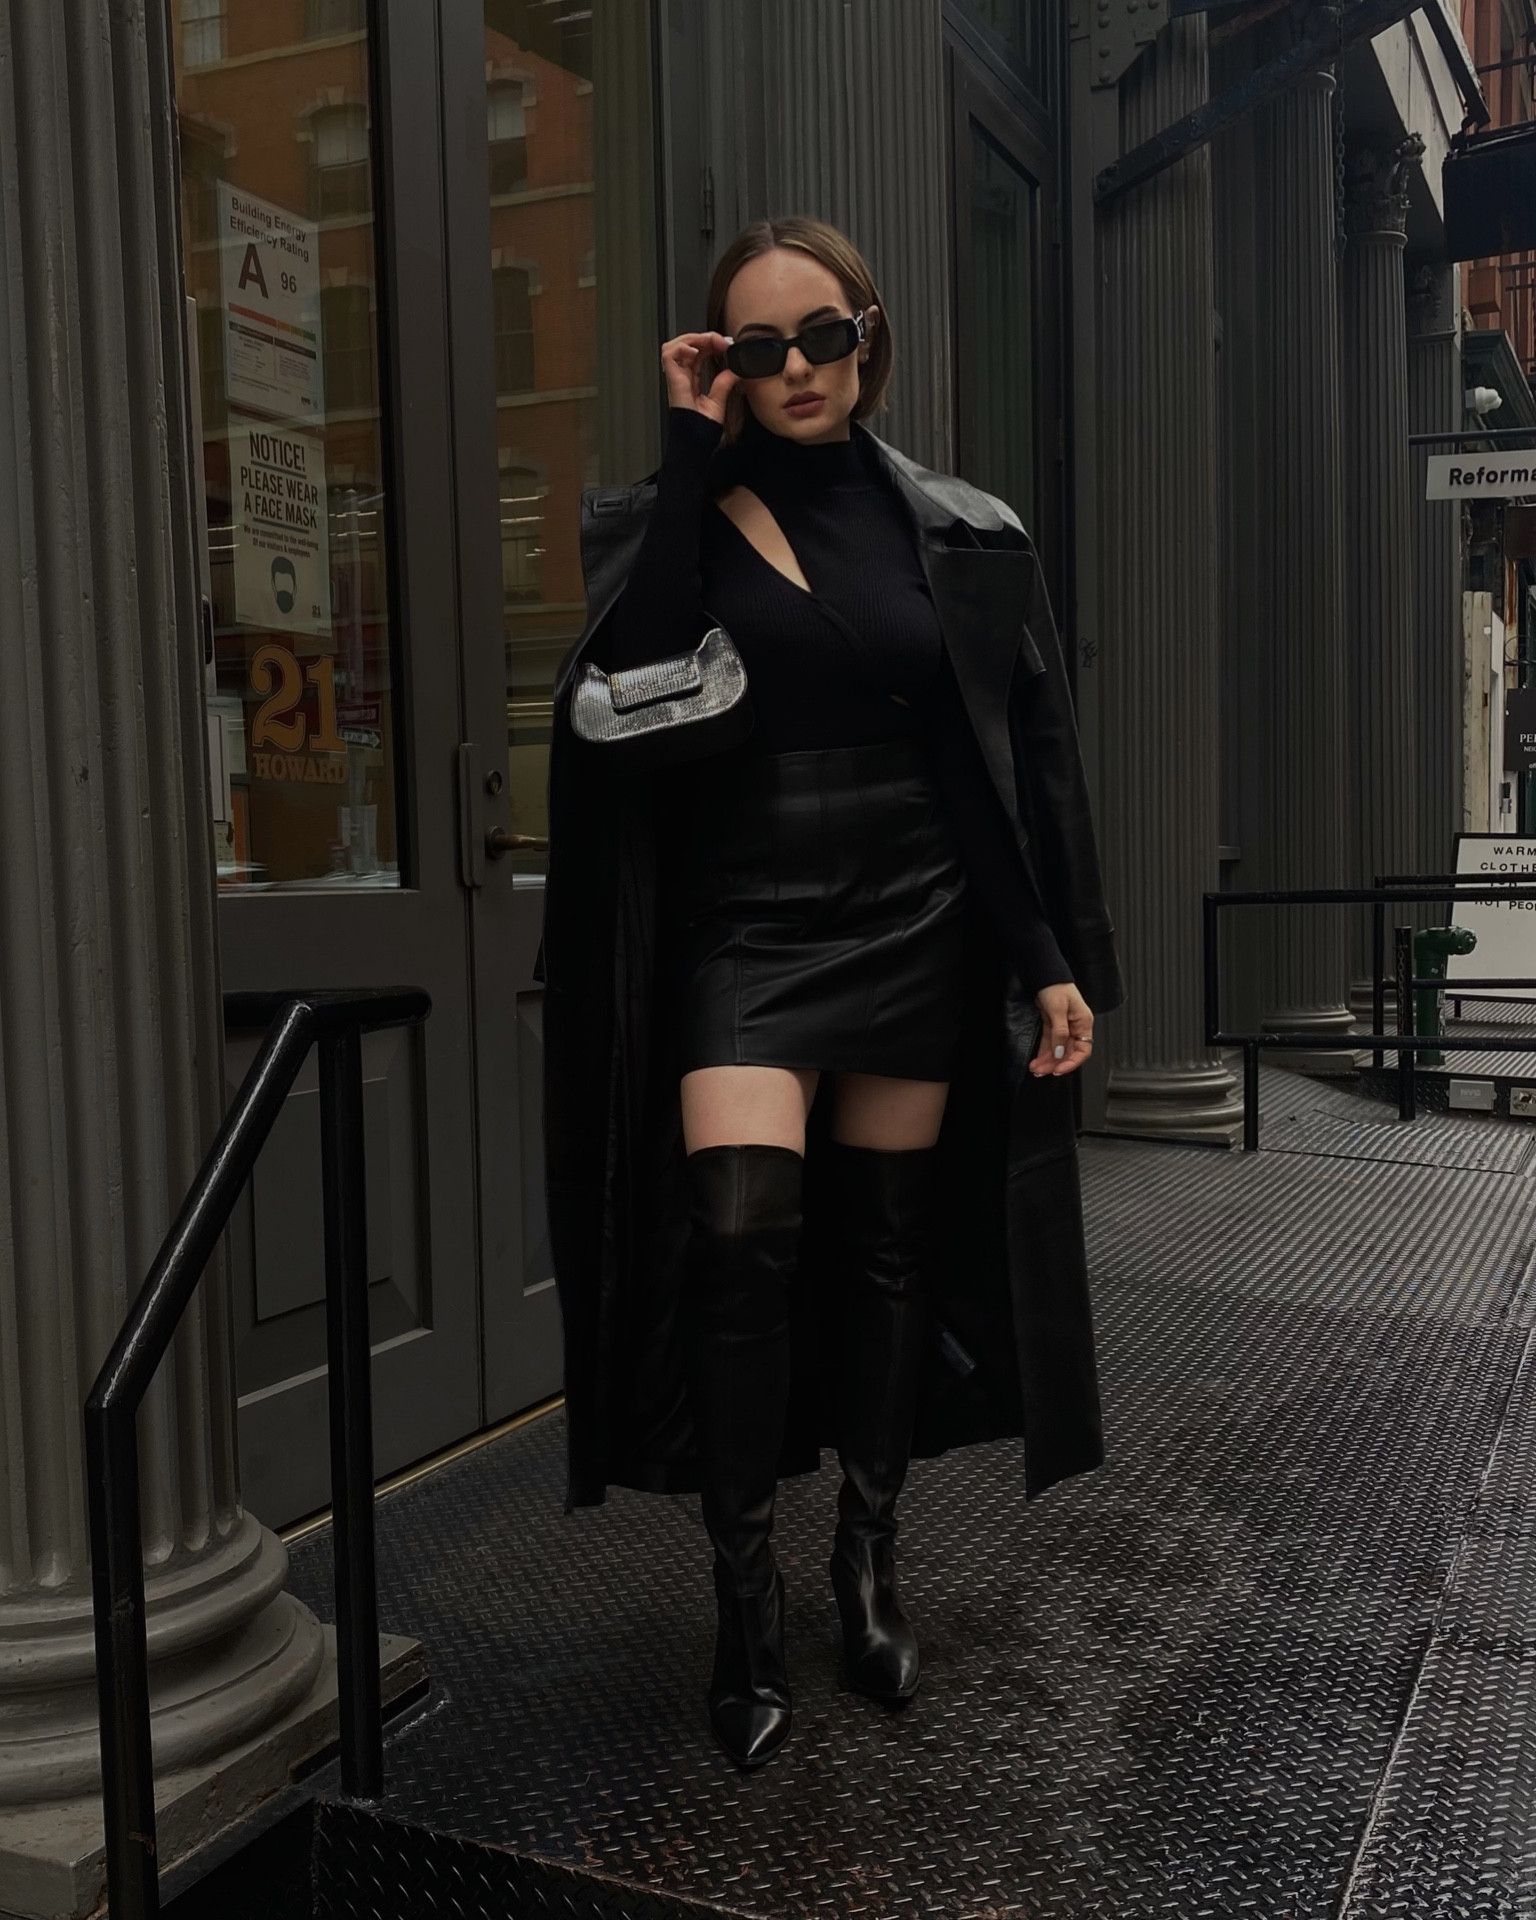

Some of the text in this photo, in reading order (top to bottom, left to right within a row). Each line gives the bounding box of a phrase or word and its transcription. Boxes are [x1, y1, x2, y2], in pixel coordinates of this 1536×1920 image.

[230, 216, 309, 262] Efficiency Rating
[231, 197, 306, 242] Building Energy
[238, 243, 268, 299] A
[281, 272, 297, 293] 96
[250, 431, 306, 472] NOTICE!
[241, 466, 318, 505] PLEASE WEAR
[244, 492, 317, 528] A FACE MASK
[250, 644, 347, 753] 21
[252, 753, 347, 784] HOWARD
[1493, 846, 1536, 855] WARM
